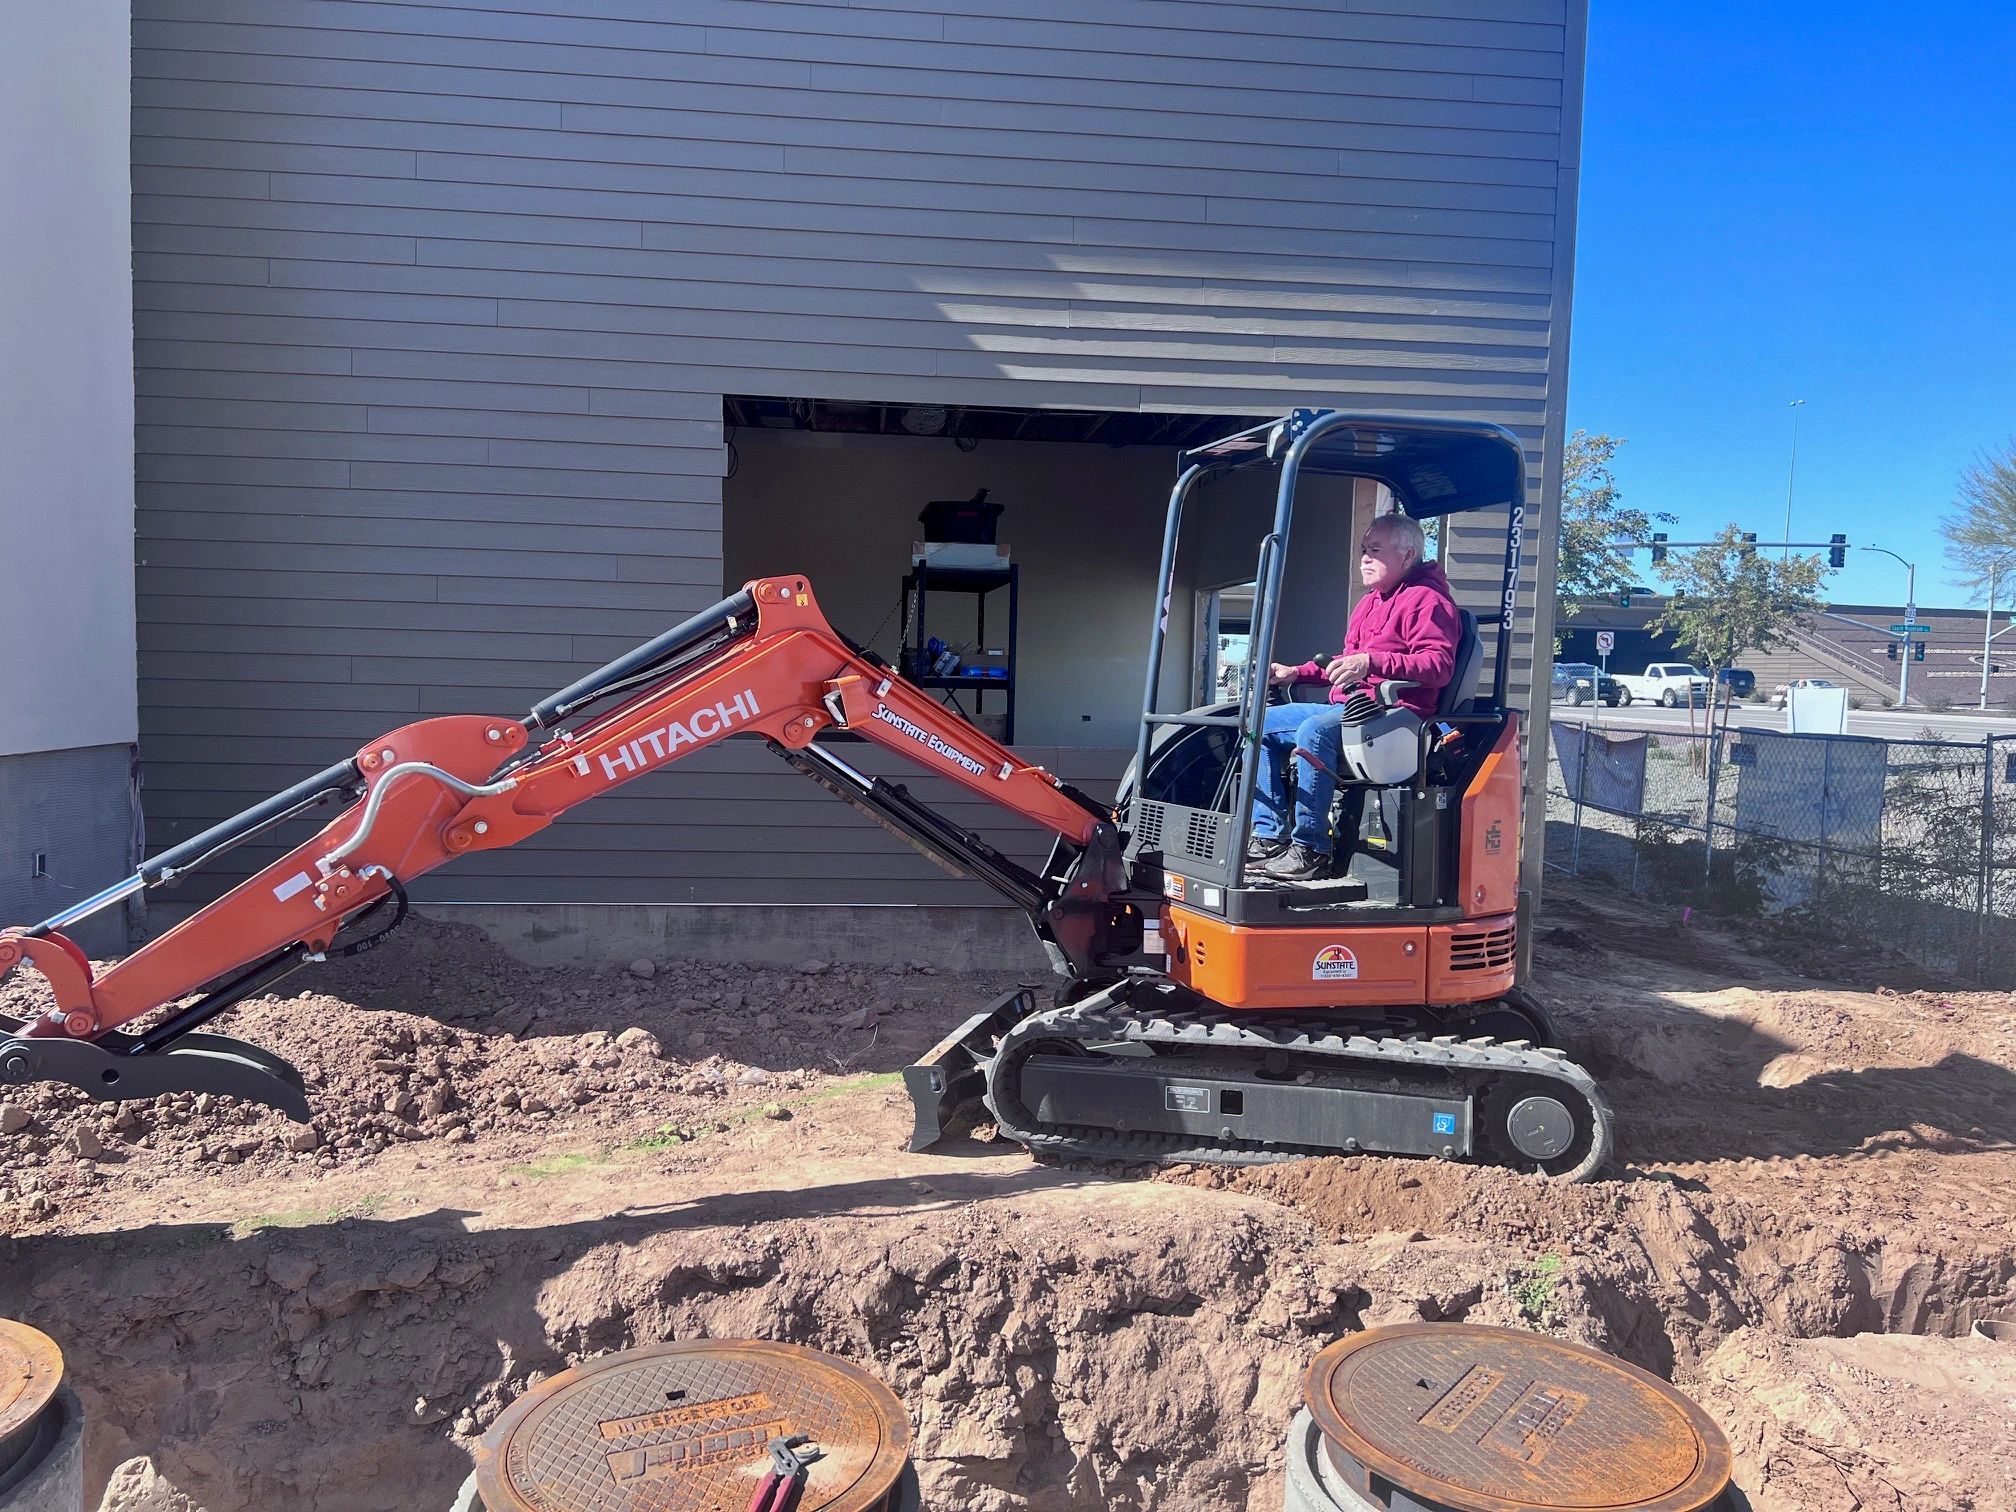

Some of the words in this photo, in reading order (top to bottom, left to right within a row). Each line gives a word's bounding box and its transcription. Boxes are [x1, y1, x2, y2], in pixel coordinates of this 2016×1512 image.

[1502, 506, 1524, 630] 231793
[599, 688, 761, 780] HITACHI
[871, 702, 928, 744] SUNSTATE
[926, 733, 986, 777] EQUIPMENT
[1315, 961, 1355, 970] SUNSTATE
